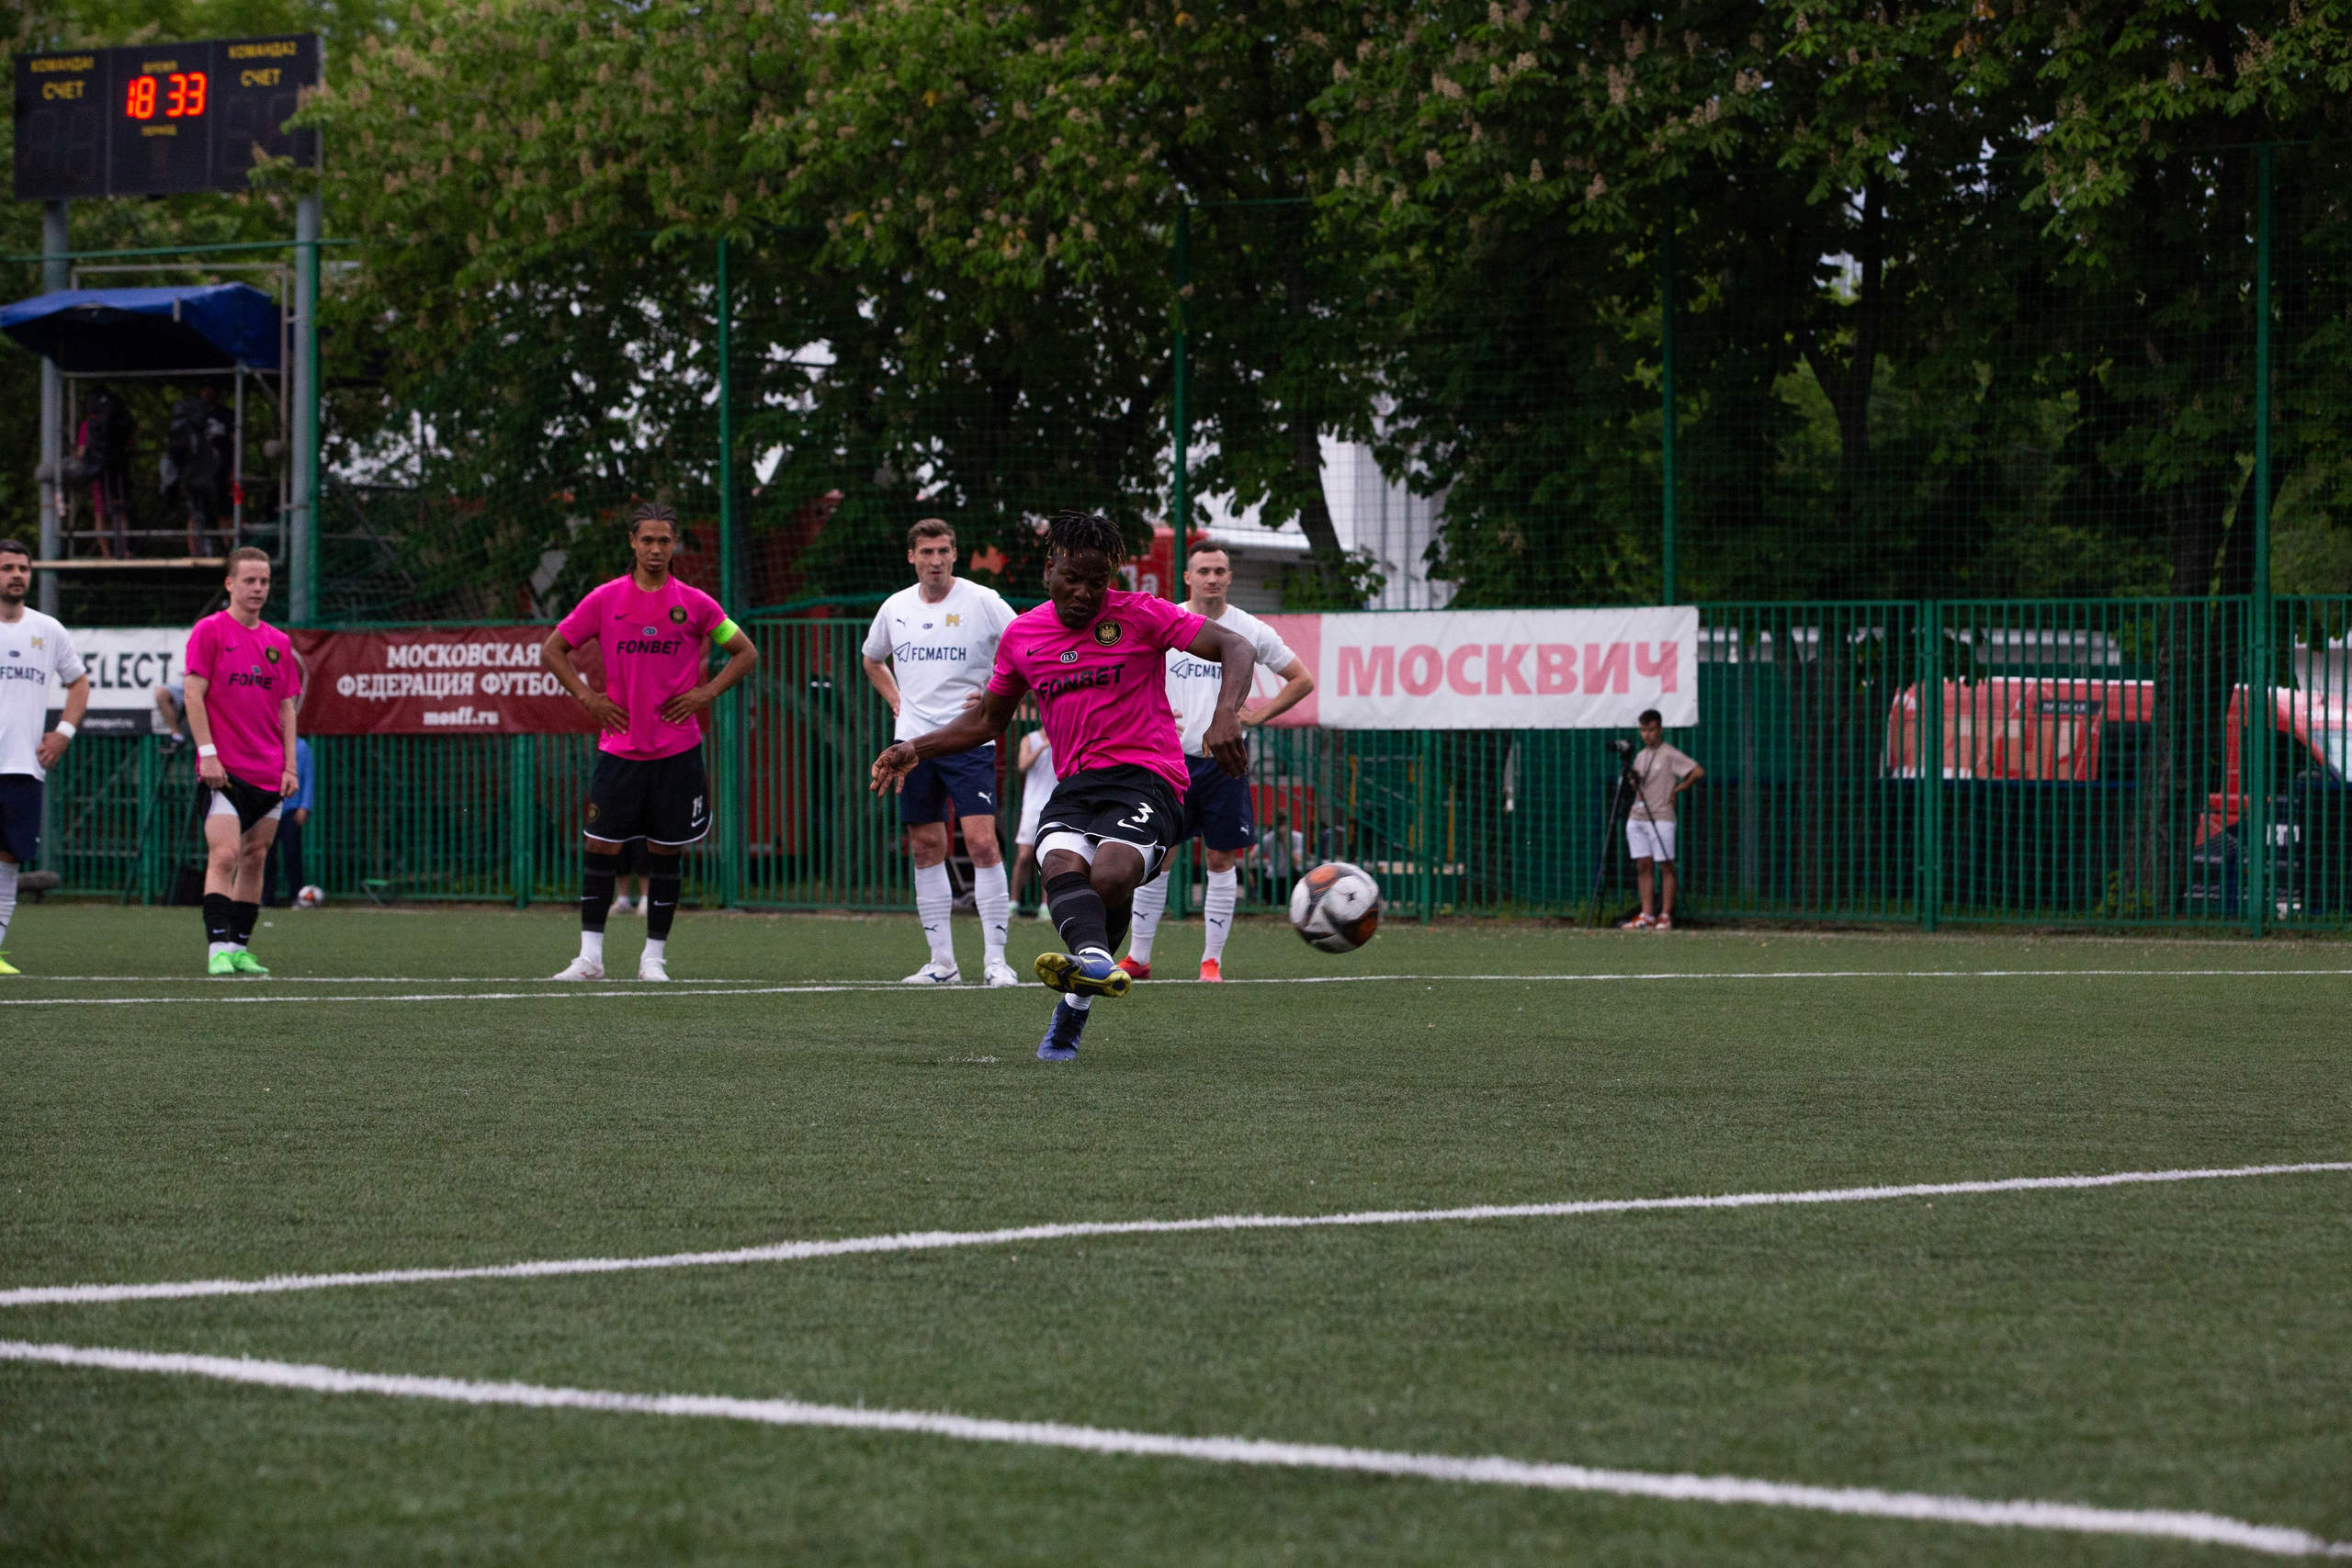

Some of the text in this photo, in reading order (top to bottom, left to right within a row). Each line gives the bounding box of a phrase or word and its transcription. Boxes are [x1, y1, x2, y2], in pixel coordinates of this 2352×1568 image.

[241, 68, 281, 87] СЧЕТ
[42, 80, 85, 100] СЧЕТ
[126, 72, 207, 119] 18 33
[386, 643, 542, 669] МОСКОВСКАЯ
[616, 640, 682, 655] FONBET
[911, 647, 967, 661] FCMATCH
[62, 652, 173, 689] ELECT
[1188, 663, 1222, 679] FCMAT
[1337, 640, 1679, 697] МОСКВИЧ
[336, 671, 589, 702] ФЕДЕРАЦИЯ ФУТБО
[1038, 664, 1125, 701] FONBET
[423, 706, 500, 726] mosff.ru
[1131, 802, 1154, 823] 3
